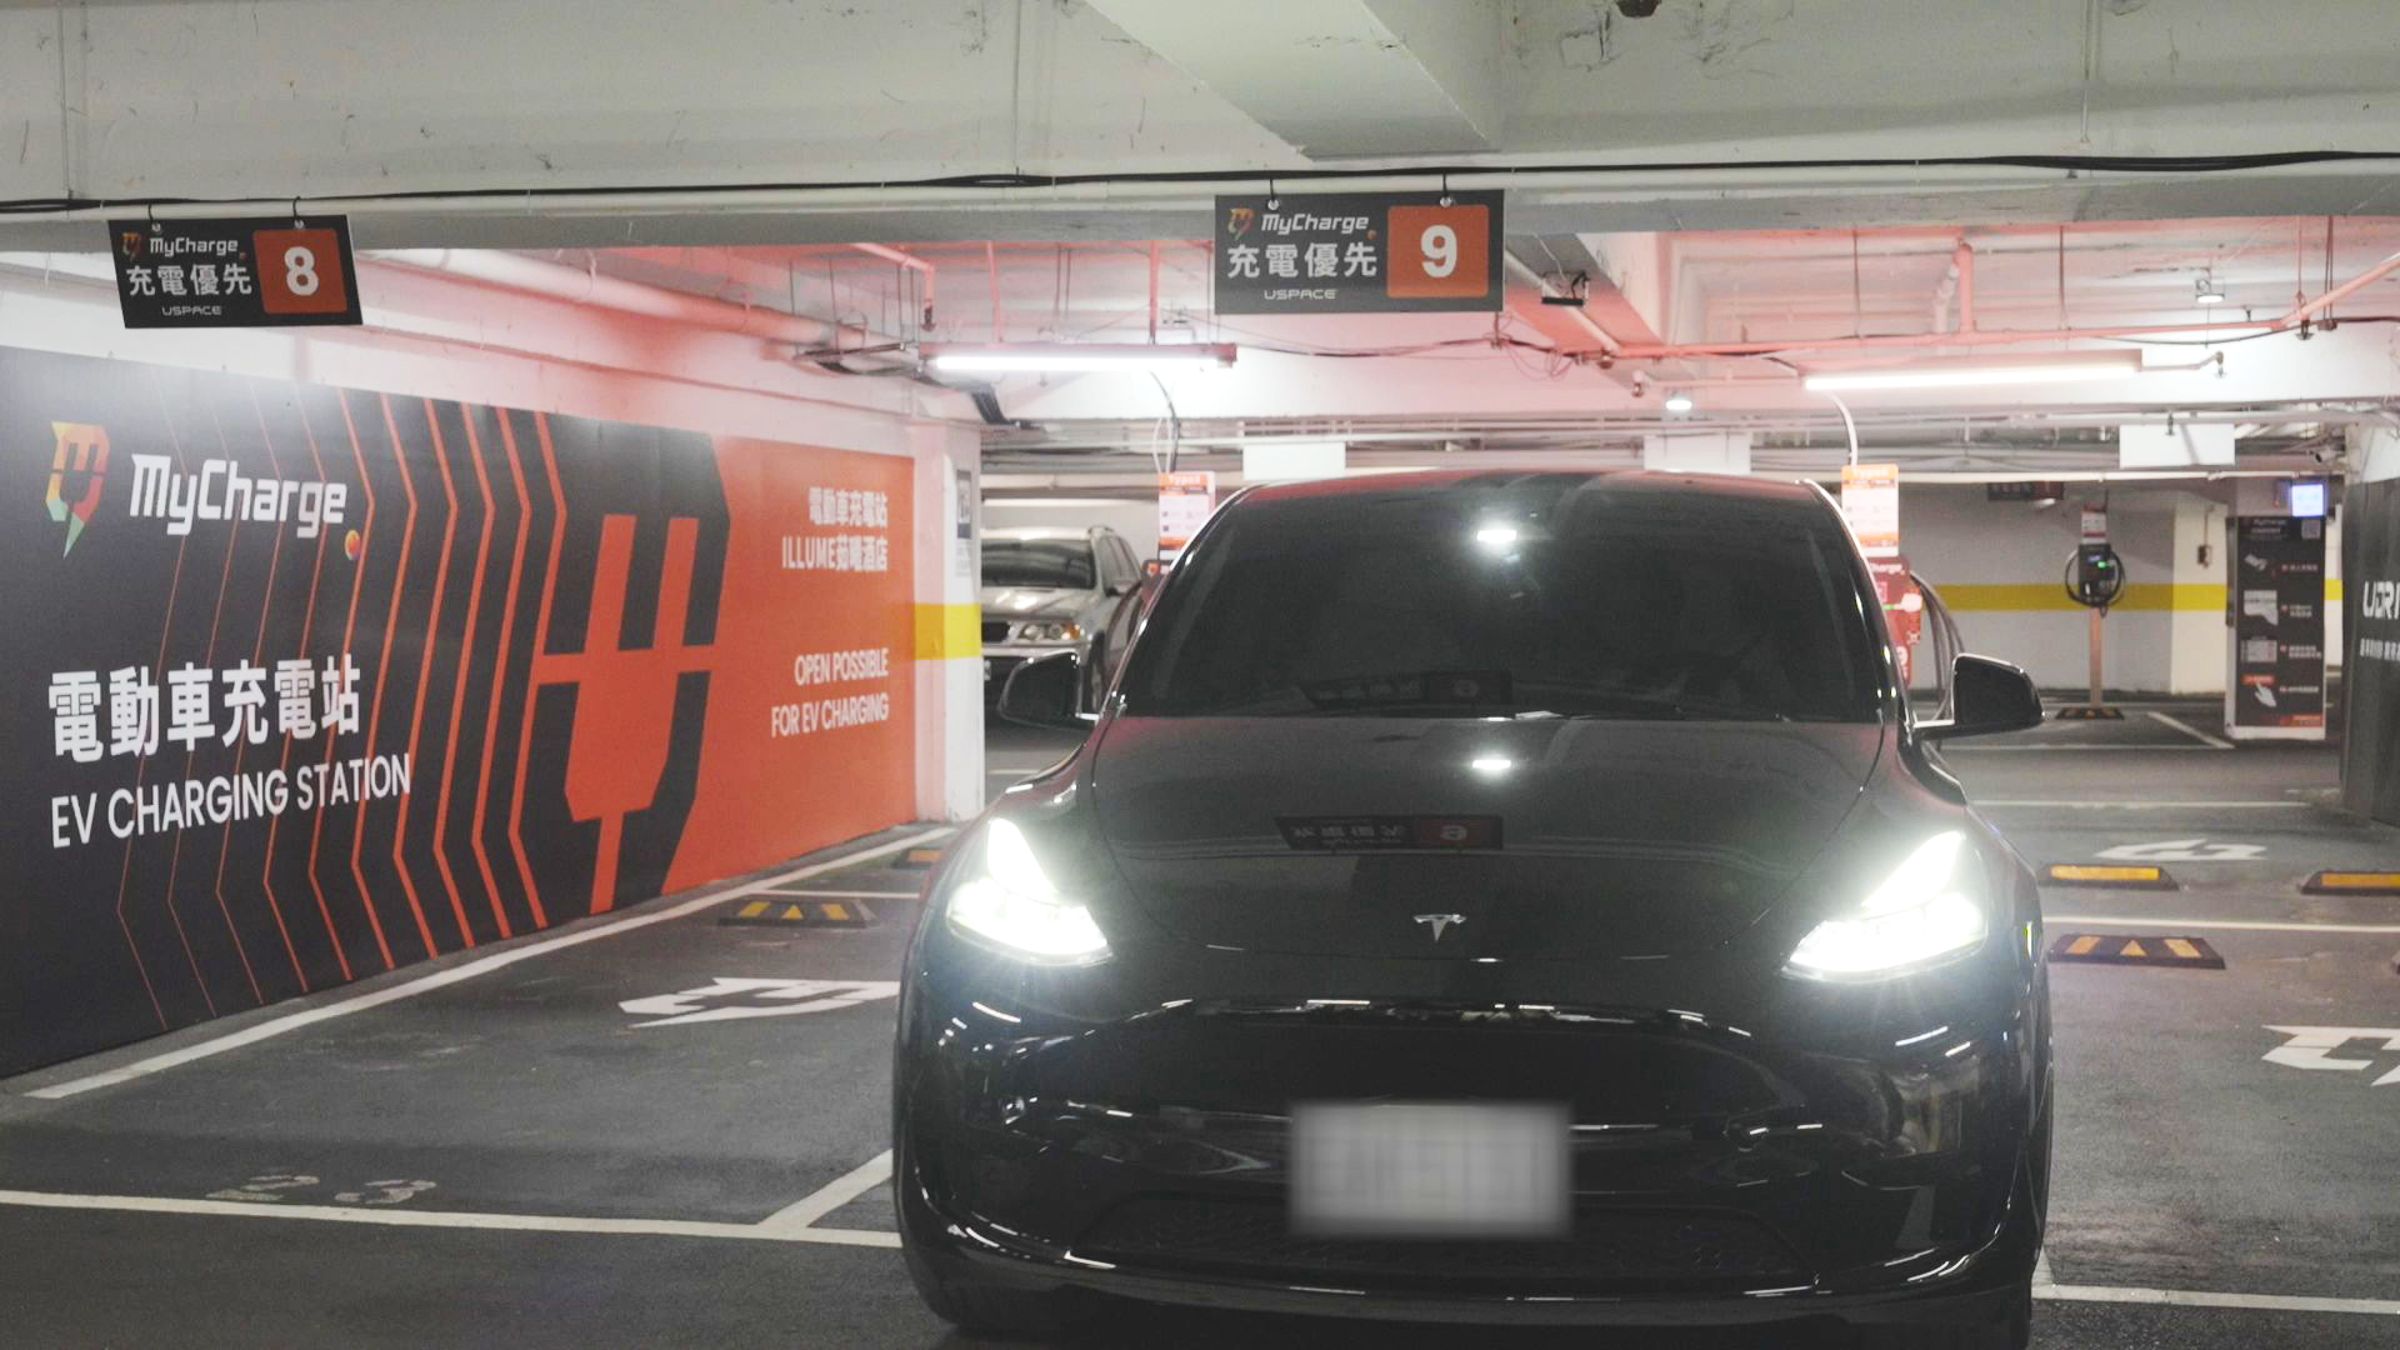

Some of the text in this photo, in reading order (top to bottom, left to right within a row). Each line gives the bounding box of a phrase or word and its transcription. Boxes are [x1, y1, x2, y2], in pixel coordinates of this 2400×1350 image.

[1261, 212, 1369, 236] MyCharge
[149, 237, 238, 257] MyCharge
[1227, 242, 1377, 278] 充電優先
[1420, 225, 1458, 278] 9
[126, 263, 253, 296] 充電優先
[284, 246, 319, 296] 8
[161, 305, 222, 316] USPACE
[1264, 289, 1337, 301] USPACE
[129, 453, 347, 539] MyCharge
[794, 648, 889, 686] OPEN POSSIBLE
[48, 653, 361, 763] 電動車充電站
[771, 692, 889, 738] FOR EV CHARGING
[51, 753, 411, 848] EV CHARGING STATION
